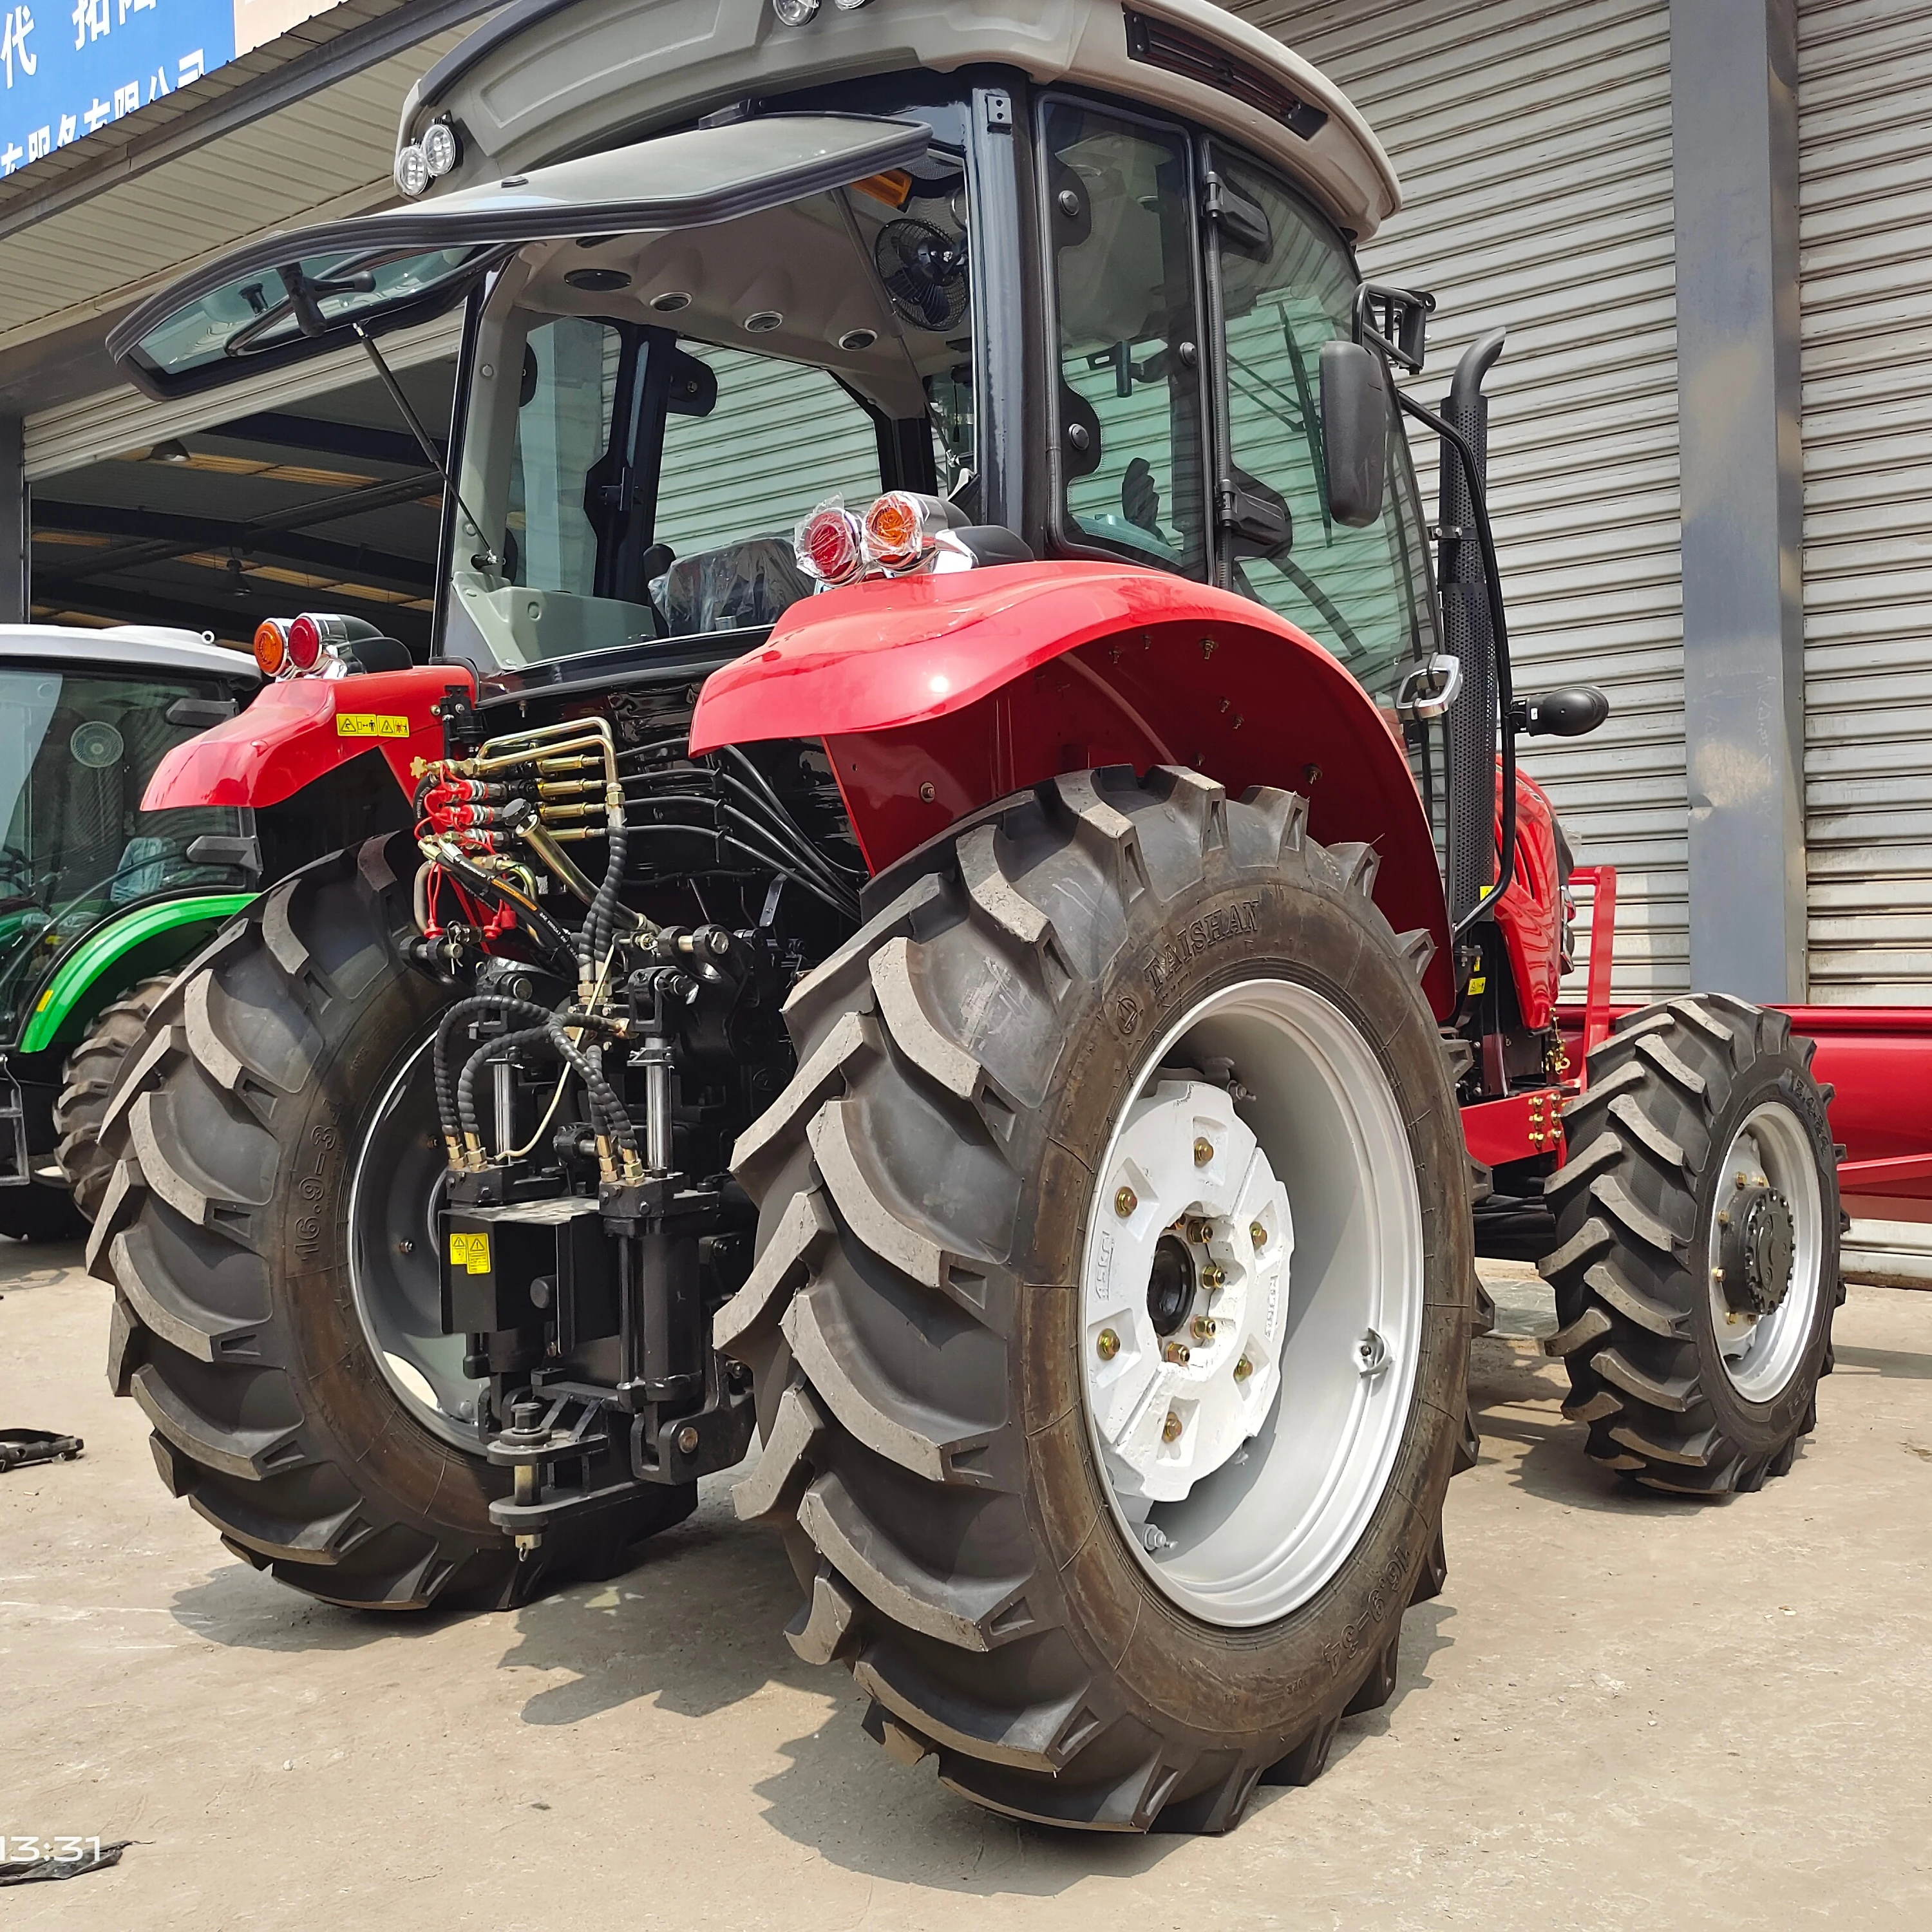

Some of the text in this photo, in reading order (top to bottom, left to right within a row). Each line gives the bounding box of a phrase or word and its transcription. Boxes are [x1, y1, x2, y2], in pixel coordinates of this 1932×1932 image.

[1, 5, 37, 89] 代
[1143, 900, 1259, 993] TAISHAN
[1323, 1546, 1410, 1677] 16.9-34
